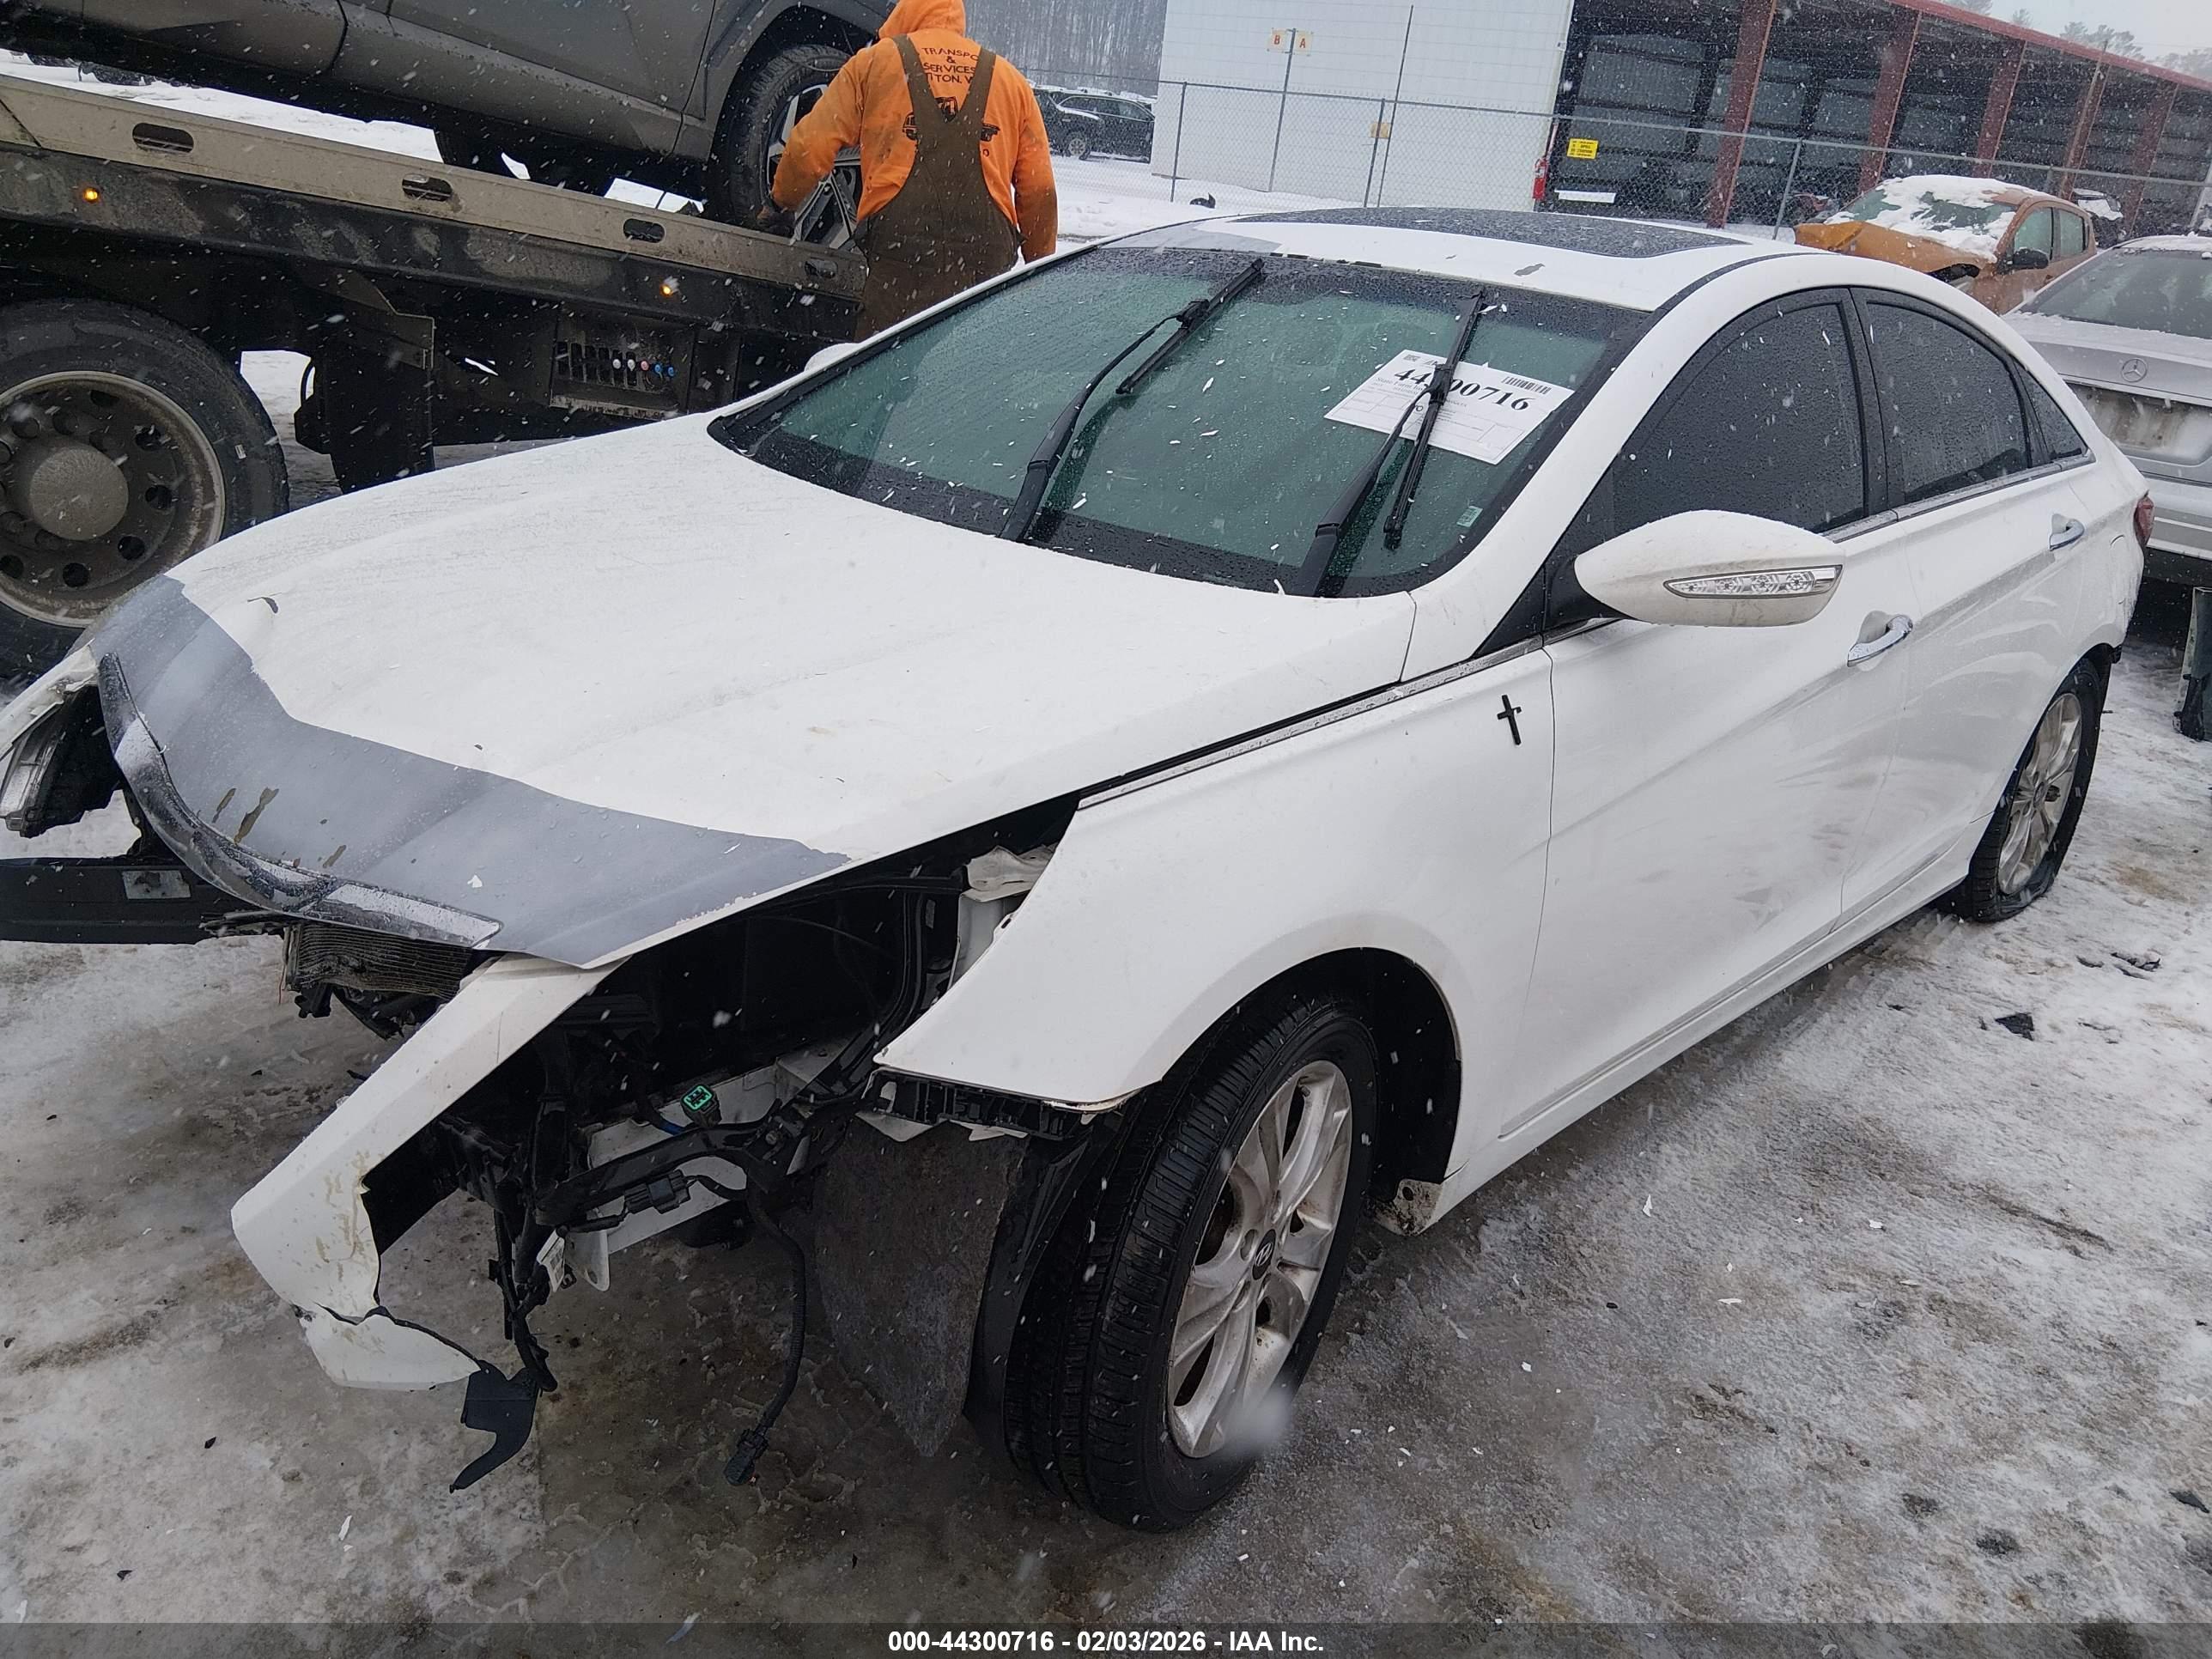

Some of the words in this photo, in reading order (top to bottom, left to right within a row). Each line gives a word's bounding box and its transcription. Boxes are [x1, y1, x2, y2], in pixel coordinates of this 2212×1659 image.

[1273, 34, 1280, 45] B
[1299, 38, 1306, 48] A
[923, 62, 976, 74] SERVICES
[1394, 368, 1535, 411] 4400716
